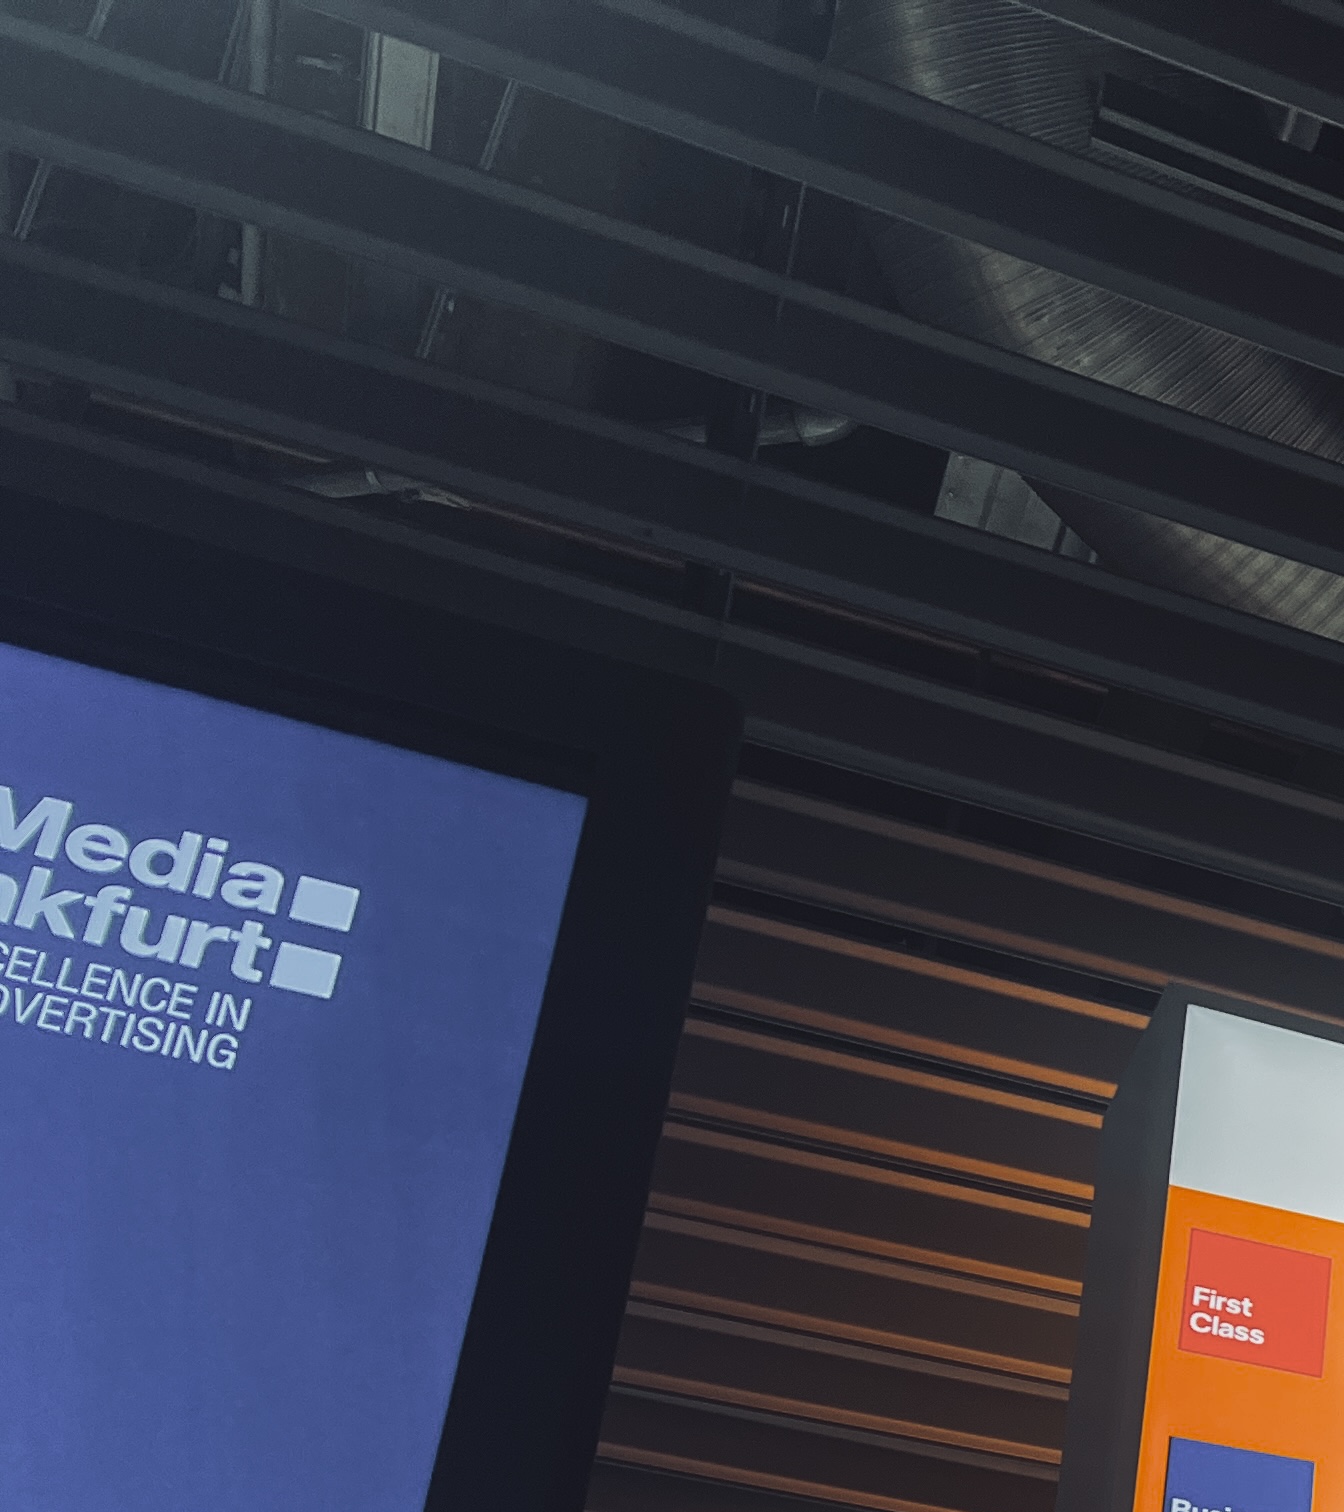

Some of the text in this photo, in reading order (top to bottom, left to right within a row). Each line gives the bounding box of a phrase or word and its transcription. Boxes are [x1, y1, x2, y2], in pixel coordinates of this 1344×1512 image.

[206, 992, 252, 1031] IN
[1192, 1286, 1253, 1318] First
[1189, 1312, 1265, 1345] Class
